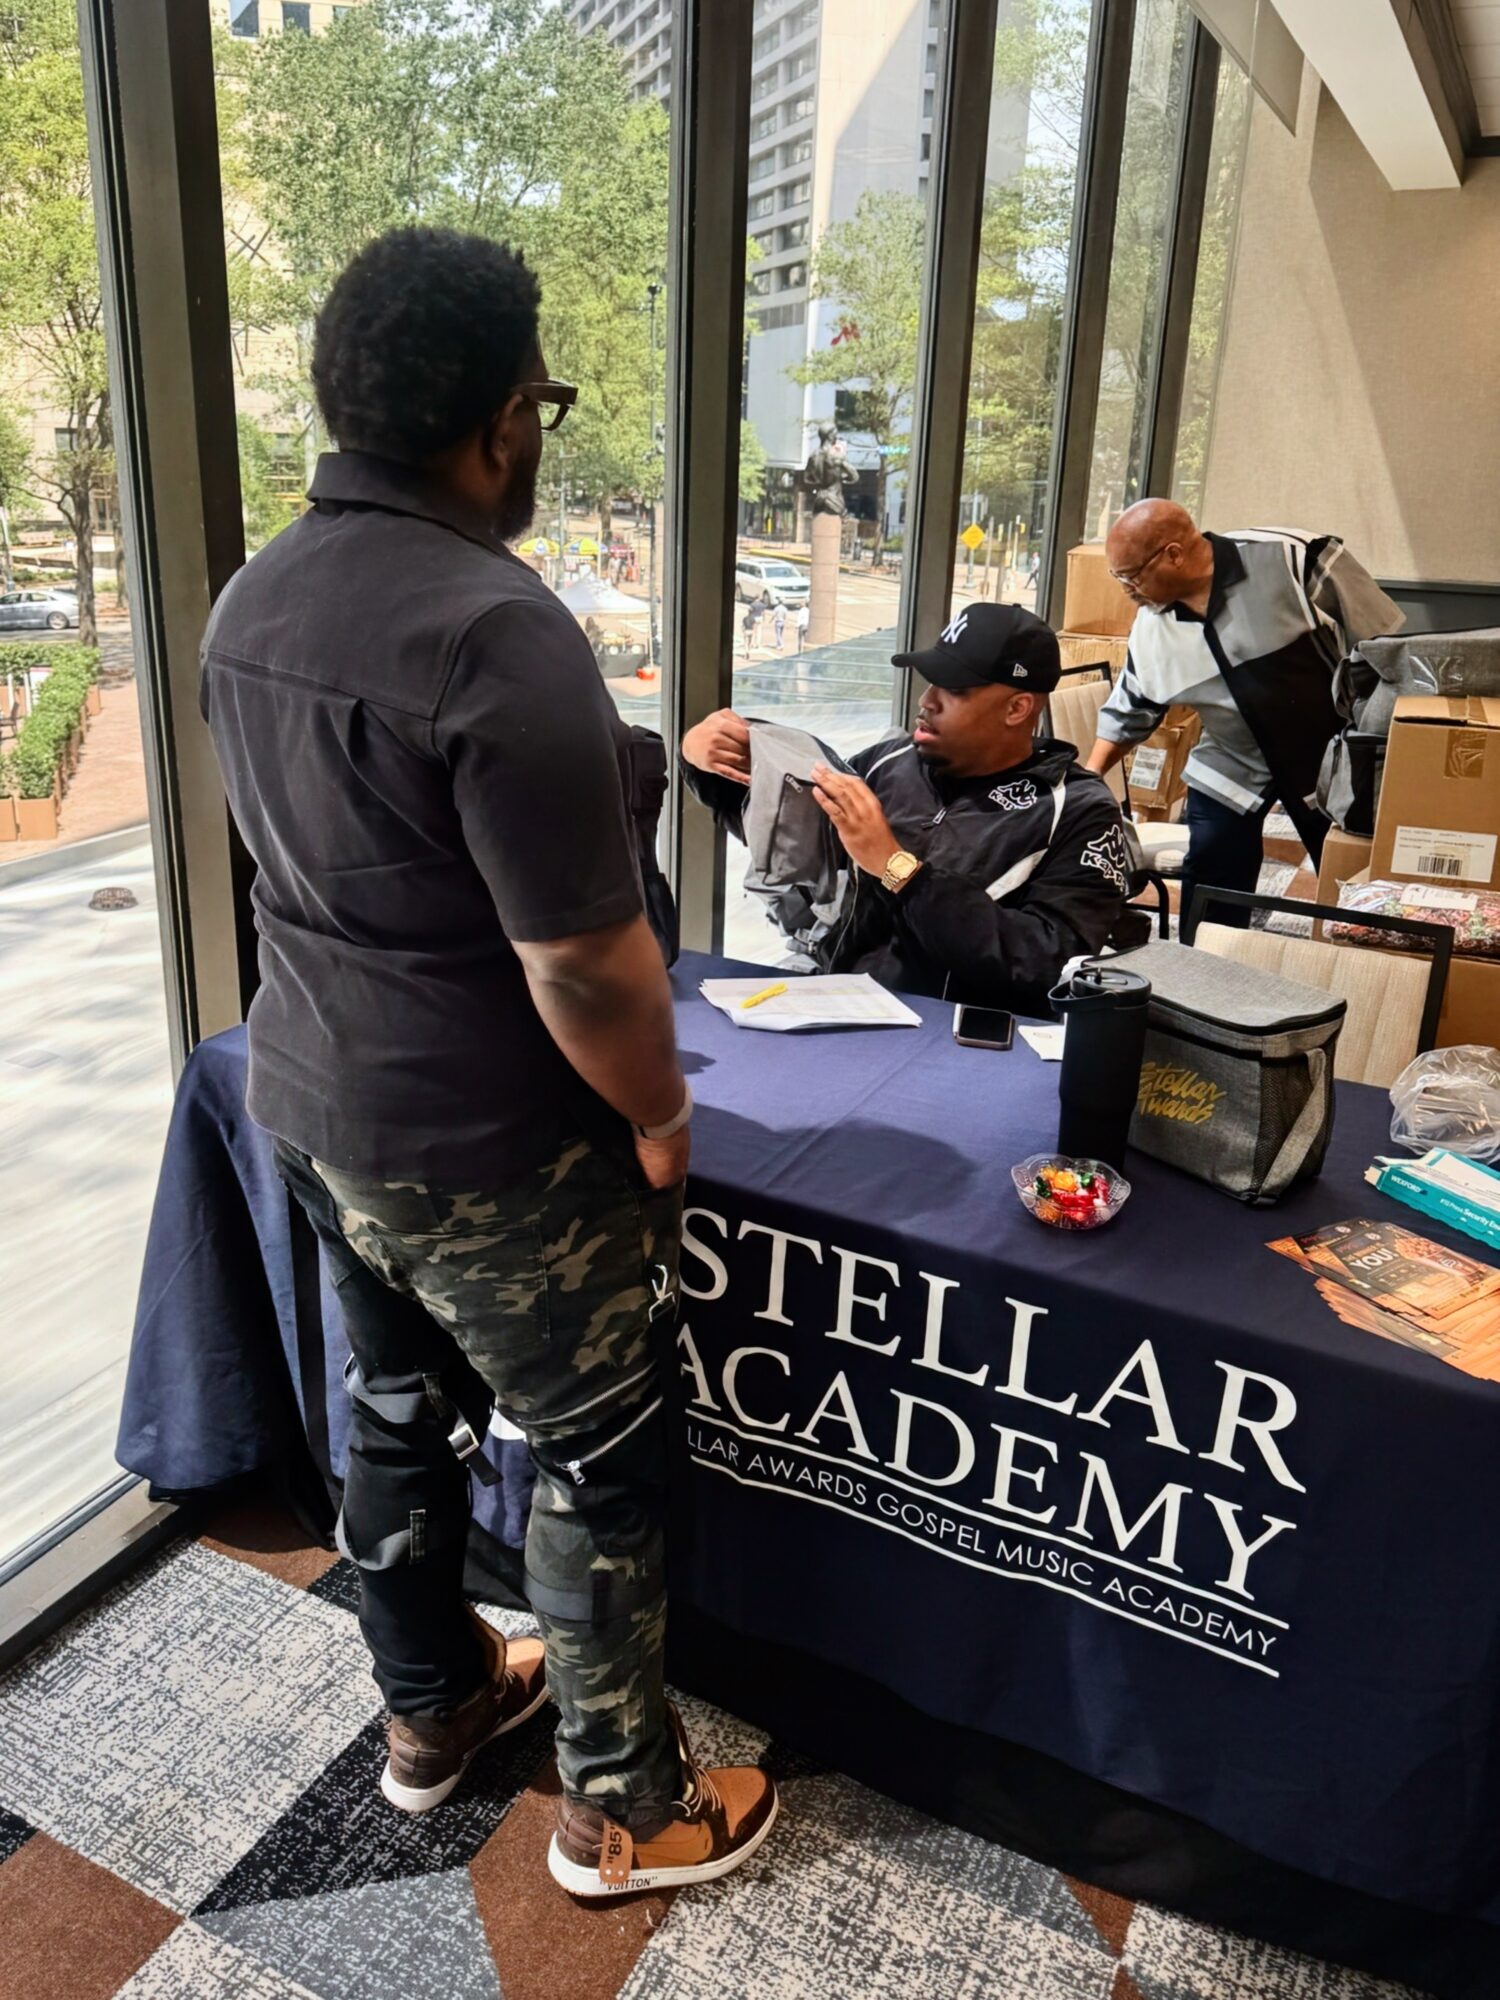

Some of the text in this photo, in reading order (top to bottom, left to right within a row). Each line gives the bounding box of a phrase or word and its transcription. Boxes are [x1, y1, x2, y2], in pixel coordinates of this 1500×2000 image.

[1391, 1174, 1422, 1194] WEXFORD
[1463, 1208, 1488, 1226] Security
[1349, 1247, 1400, 1270] YOU!
[678, 1207, 1306, 1493] STELLAR
[676, 1322, 1297, 1601] ACADEMY
[747, 1453, 867, 1506] AWARDS
[876, 1493, 986, 1554] GOSPEL
[996, 1539, 1095, 1586] MUSIC
[1102, 1577, 1277, 1656] ACADEMY
